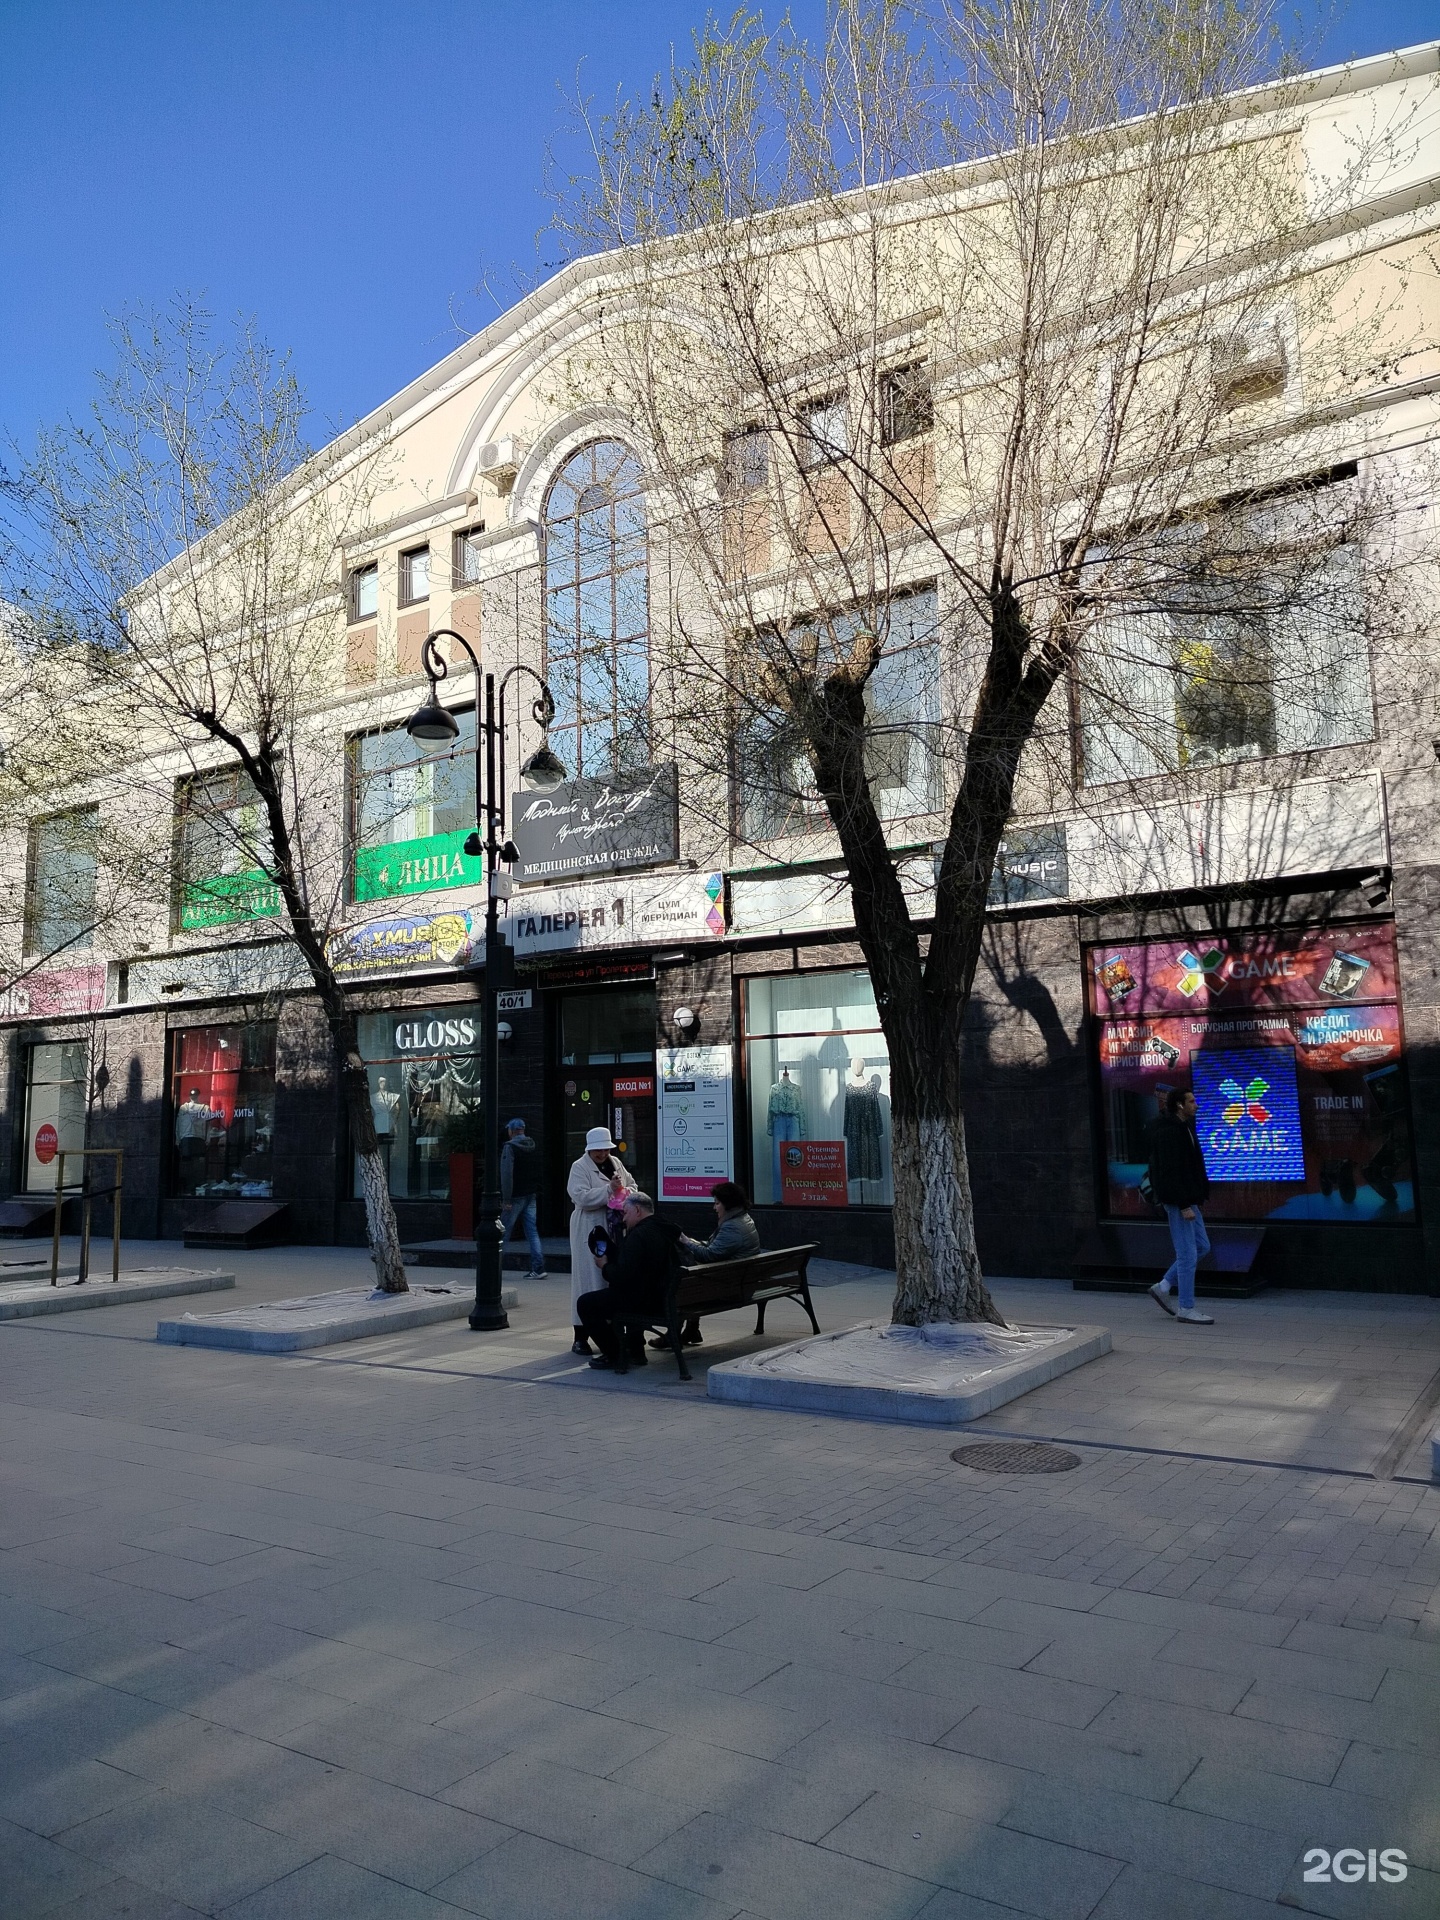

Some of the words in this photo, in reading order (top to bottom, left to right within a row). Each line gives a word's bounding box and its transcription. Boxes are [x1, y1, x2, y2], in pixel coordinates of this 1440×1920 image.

[581, 807, 591, 822] &
[523, 852, 608, 876] МЕДИЦИНСКАЯ
[610, 844, 661, 862] ОДЕЖДА
[398, 852, 466, 886] ЛИЦА
[658, 900, 681, 911] ЦУМ
[517, 908, 606, 938] ГАЛЕРЕЯ
[611, 897, 625, 926] 1
[641, 911, 698, 923] МЕРИДИАН
[575, 970, 585, 978] на
[585, 969, 595, 979] ул
[595, 963, 649, 977] Пролетарская
[1229, 957, 1296, 980] GAME
[500, 996, 524, 1009] 40/1
[1190, 1021, 1236, 1034] БОНУСНАЯ
[1236, 1018, 1290, 1031] ПРОГРАММА
[1306, 1014, 1350, 1029] КРЕДИТ
[395, 1017, 477, 1050] GLOSS
[1107, 1025, 1154, 1040] МАГАЗИН
[1307, 1032, 1314, 1044] И
[1318, 1028, 1384, 1044] РАССРОЧКА
[1108, 1039, 1155, 1054] ИГРОВЫХ
[676, 1064, 696, 1073] GAME
[1109, 1054, 1165, 1068] ПРИСТАВОК
[615, 1082, 638, 1091] ВХОД
[639, 1081, 651, 1090] №1
[1313, 1096, 1350, 1110] TRADE
[1351, 1095, 1364, 1109] IN
[197, 1109, 226, 1119] ТОЛЬКО
[233, 1108, 255, 1118] ХИТЫ
[1210, 1128, 1289, 1152] GAME
[785, 1177, 817, 1191] Русские
[818, 1180, 844, 1191] узоры
[801, 1192, 807, 1200] 2
